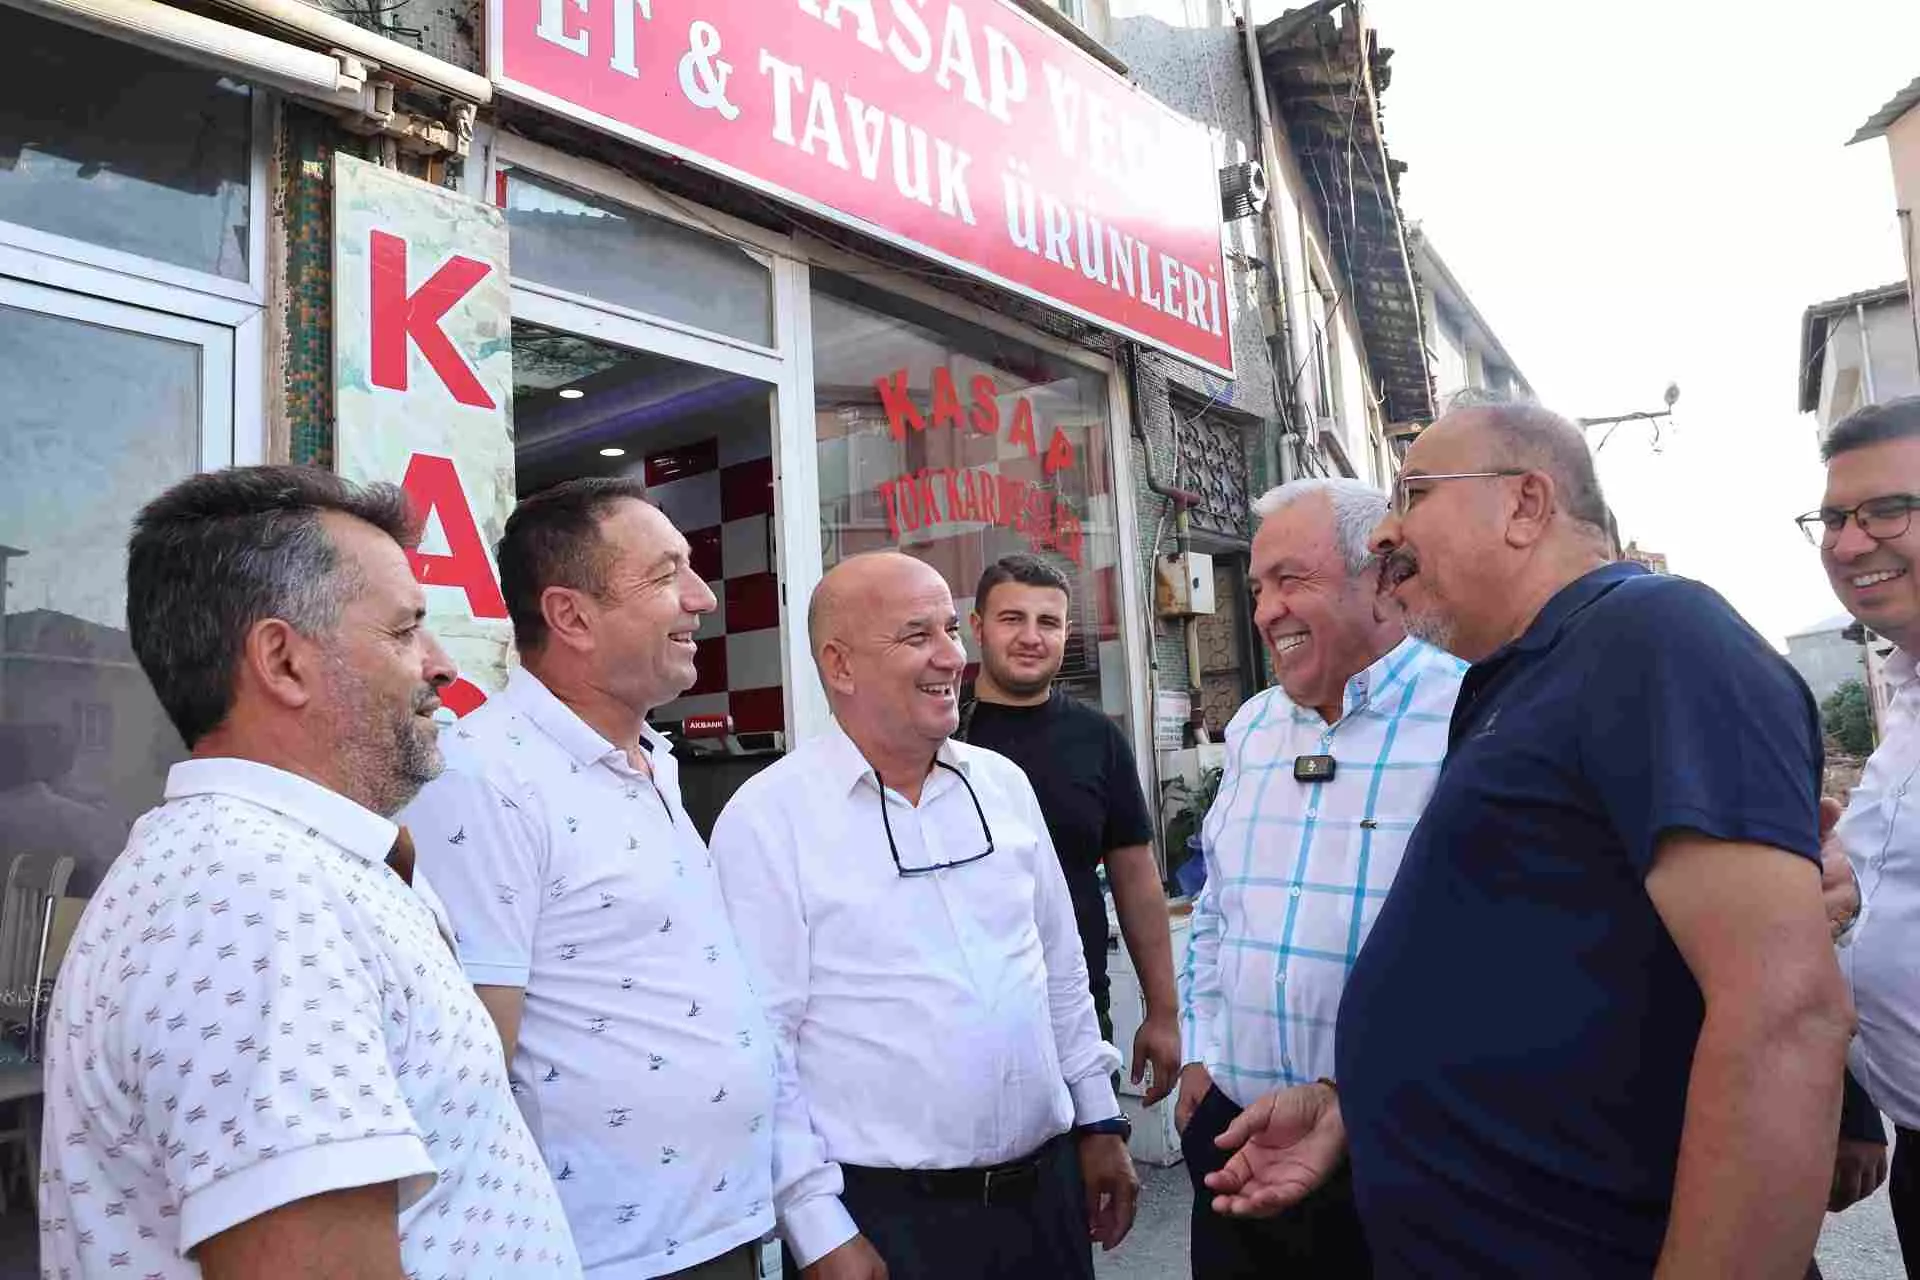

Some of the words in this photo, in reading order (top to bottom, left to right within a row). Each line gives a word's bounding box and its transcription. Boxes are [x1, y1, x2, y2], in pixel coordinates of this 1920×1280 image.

[797, 0, 1028, 124] ASAP
[536, 0, 652, 80] ET
[678, 20, 741, 121] &
[759, 48, 977, 225] TAVUK
[1003, 155, 1223, 338] ÜRÜNLERİ
[369, 228, 511, 721] KA
[872, 366, 1075, 476] KASAP
[690, 720, 724, 729] AKBANK
